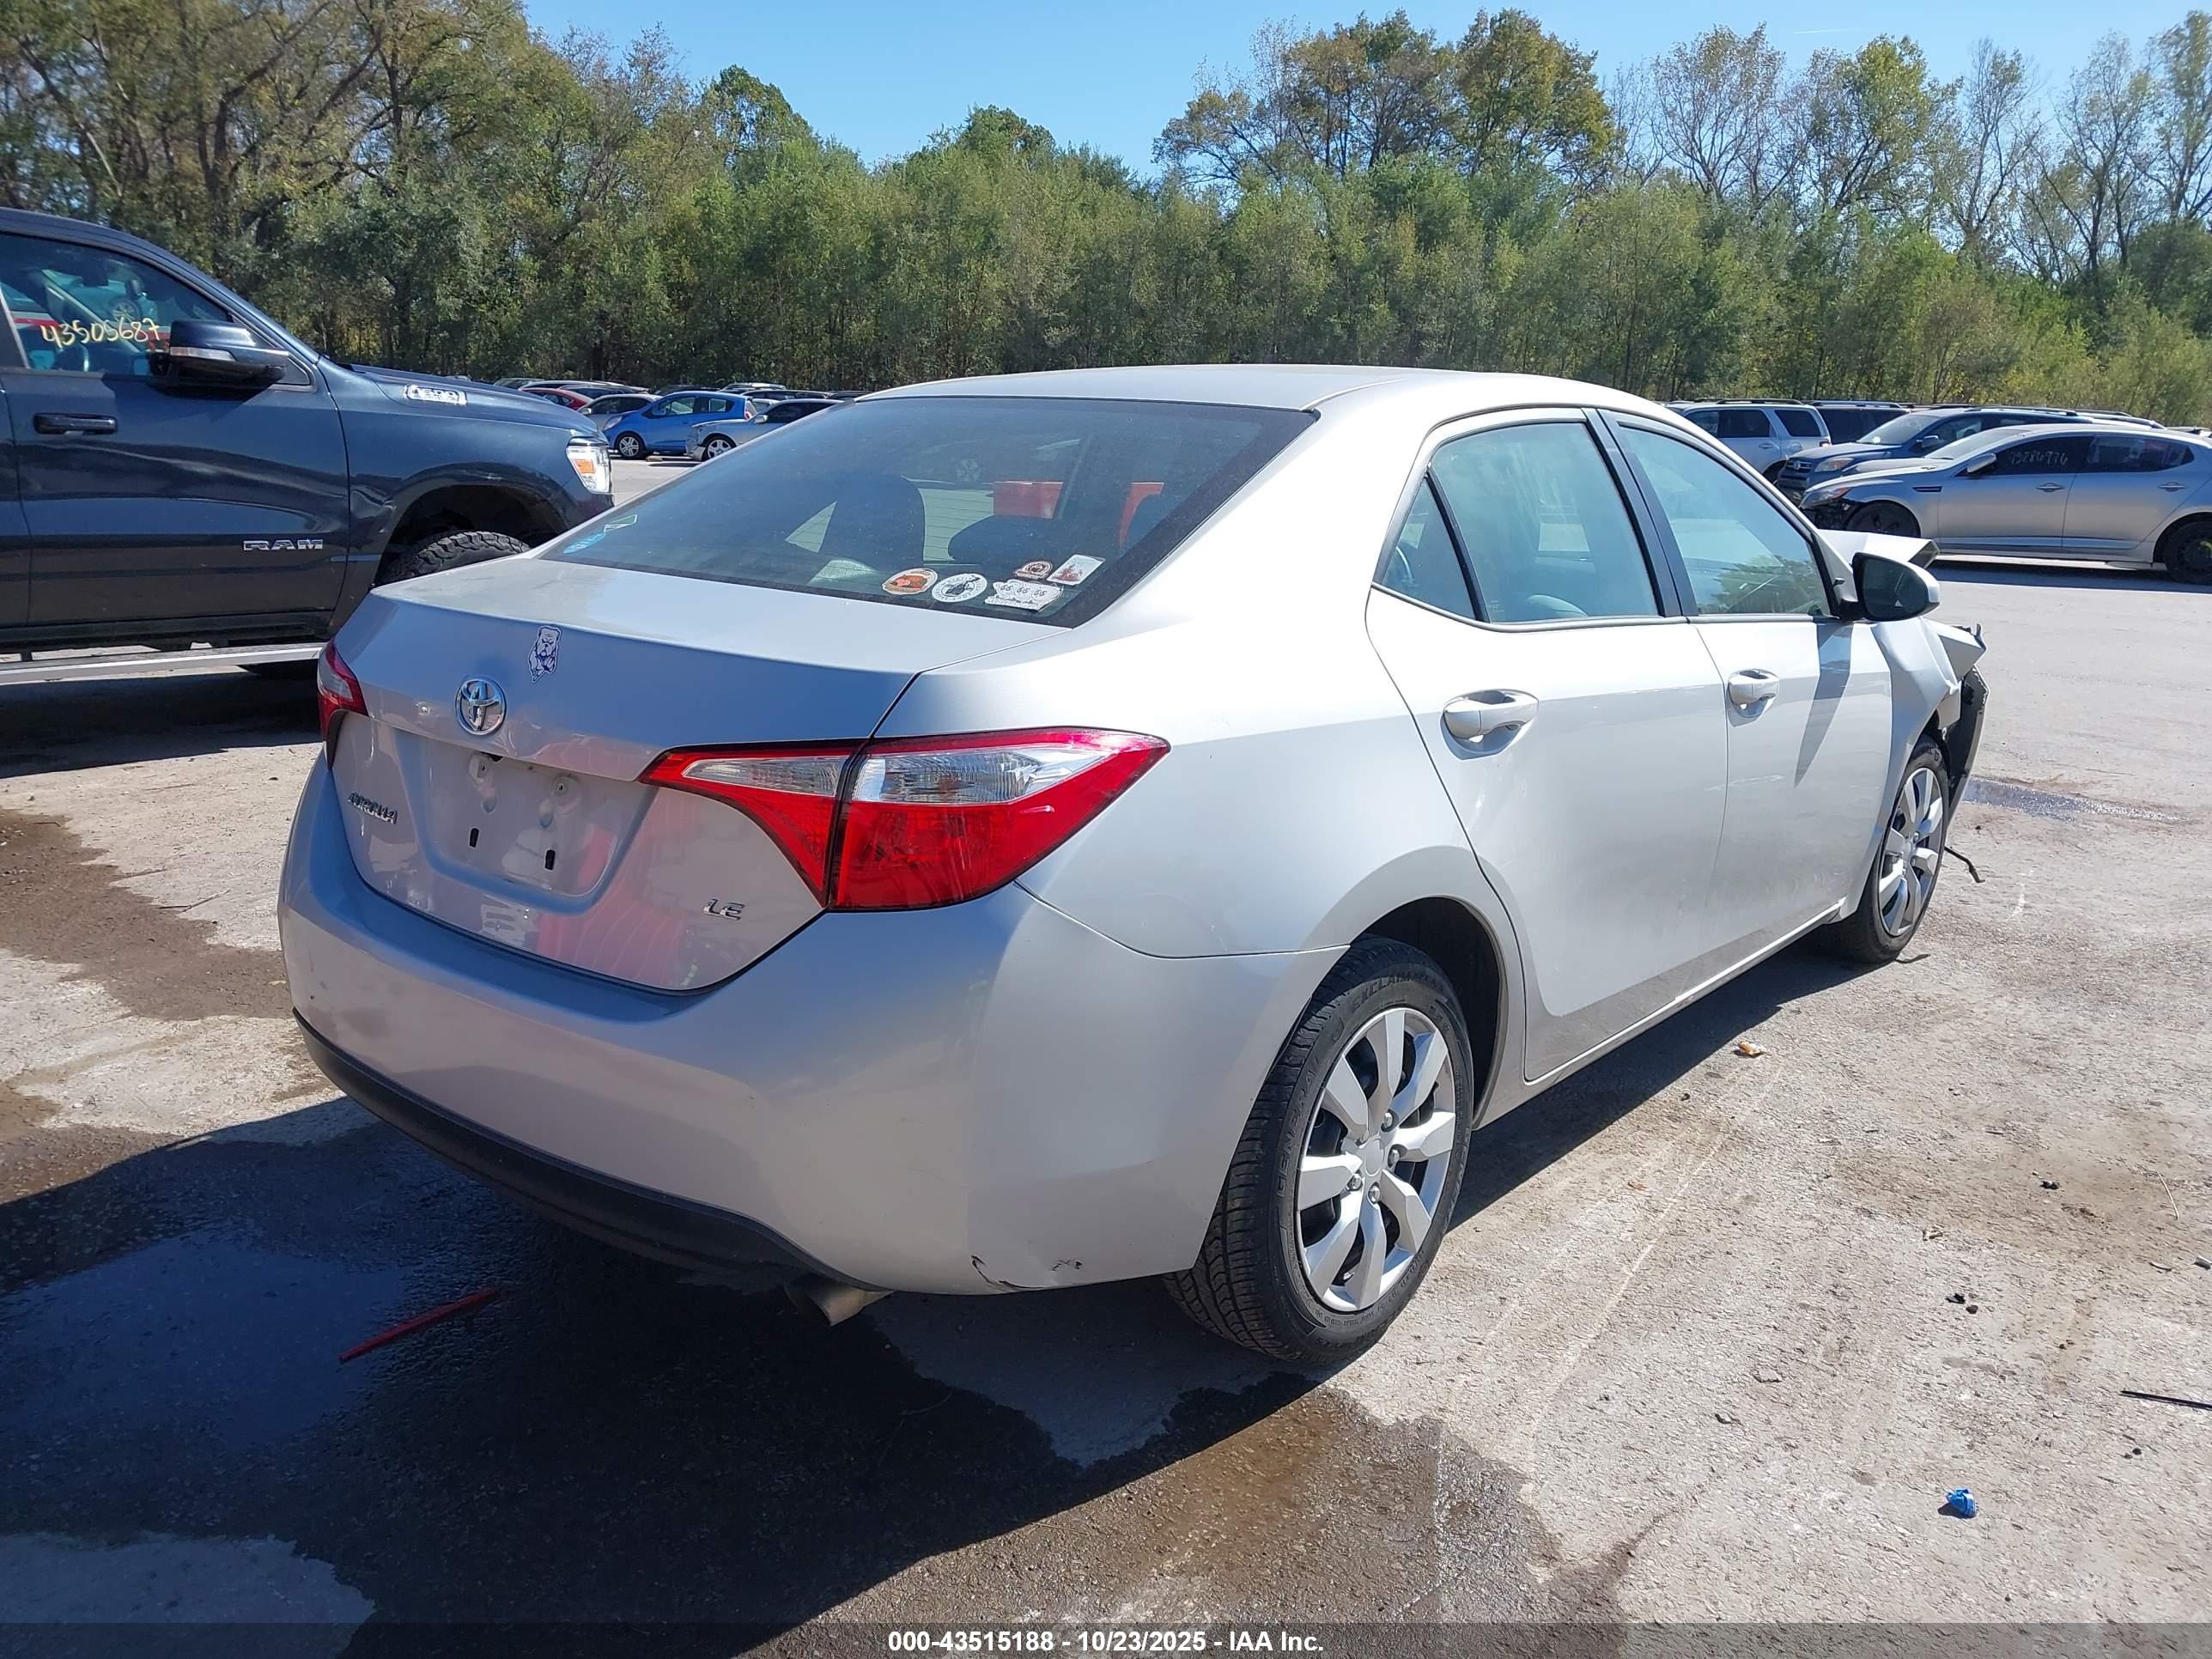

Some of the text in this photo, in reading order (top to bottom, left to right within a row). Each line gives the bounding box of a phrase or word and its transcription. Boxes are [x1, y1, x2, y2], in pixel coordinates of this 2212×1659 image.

[40, 317, 160, 349] 43505687
[243, 538, 324, 550] RAM
[704, 898, 745, 921] LE
